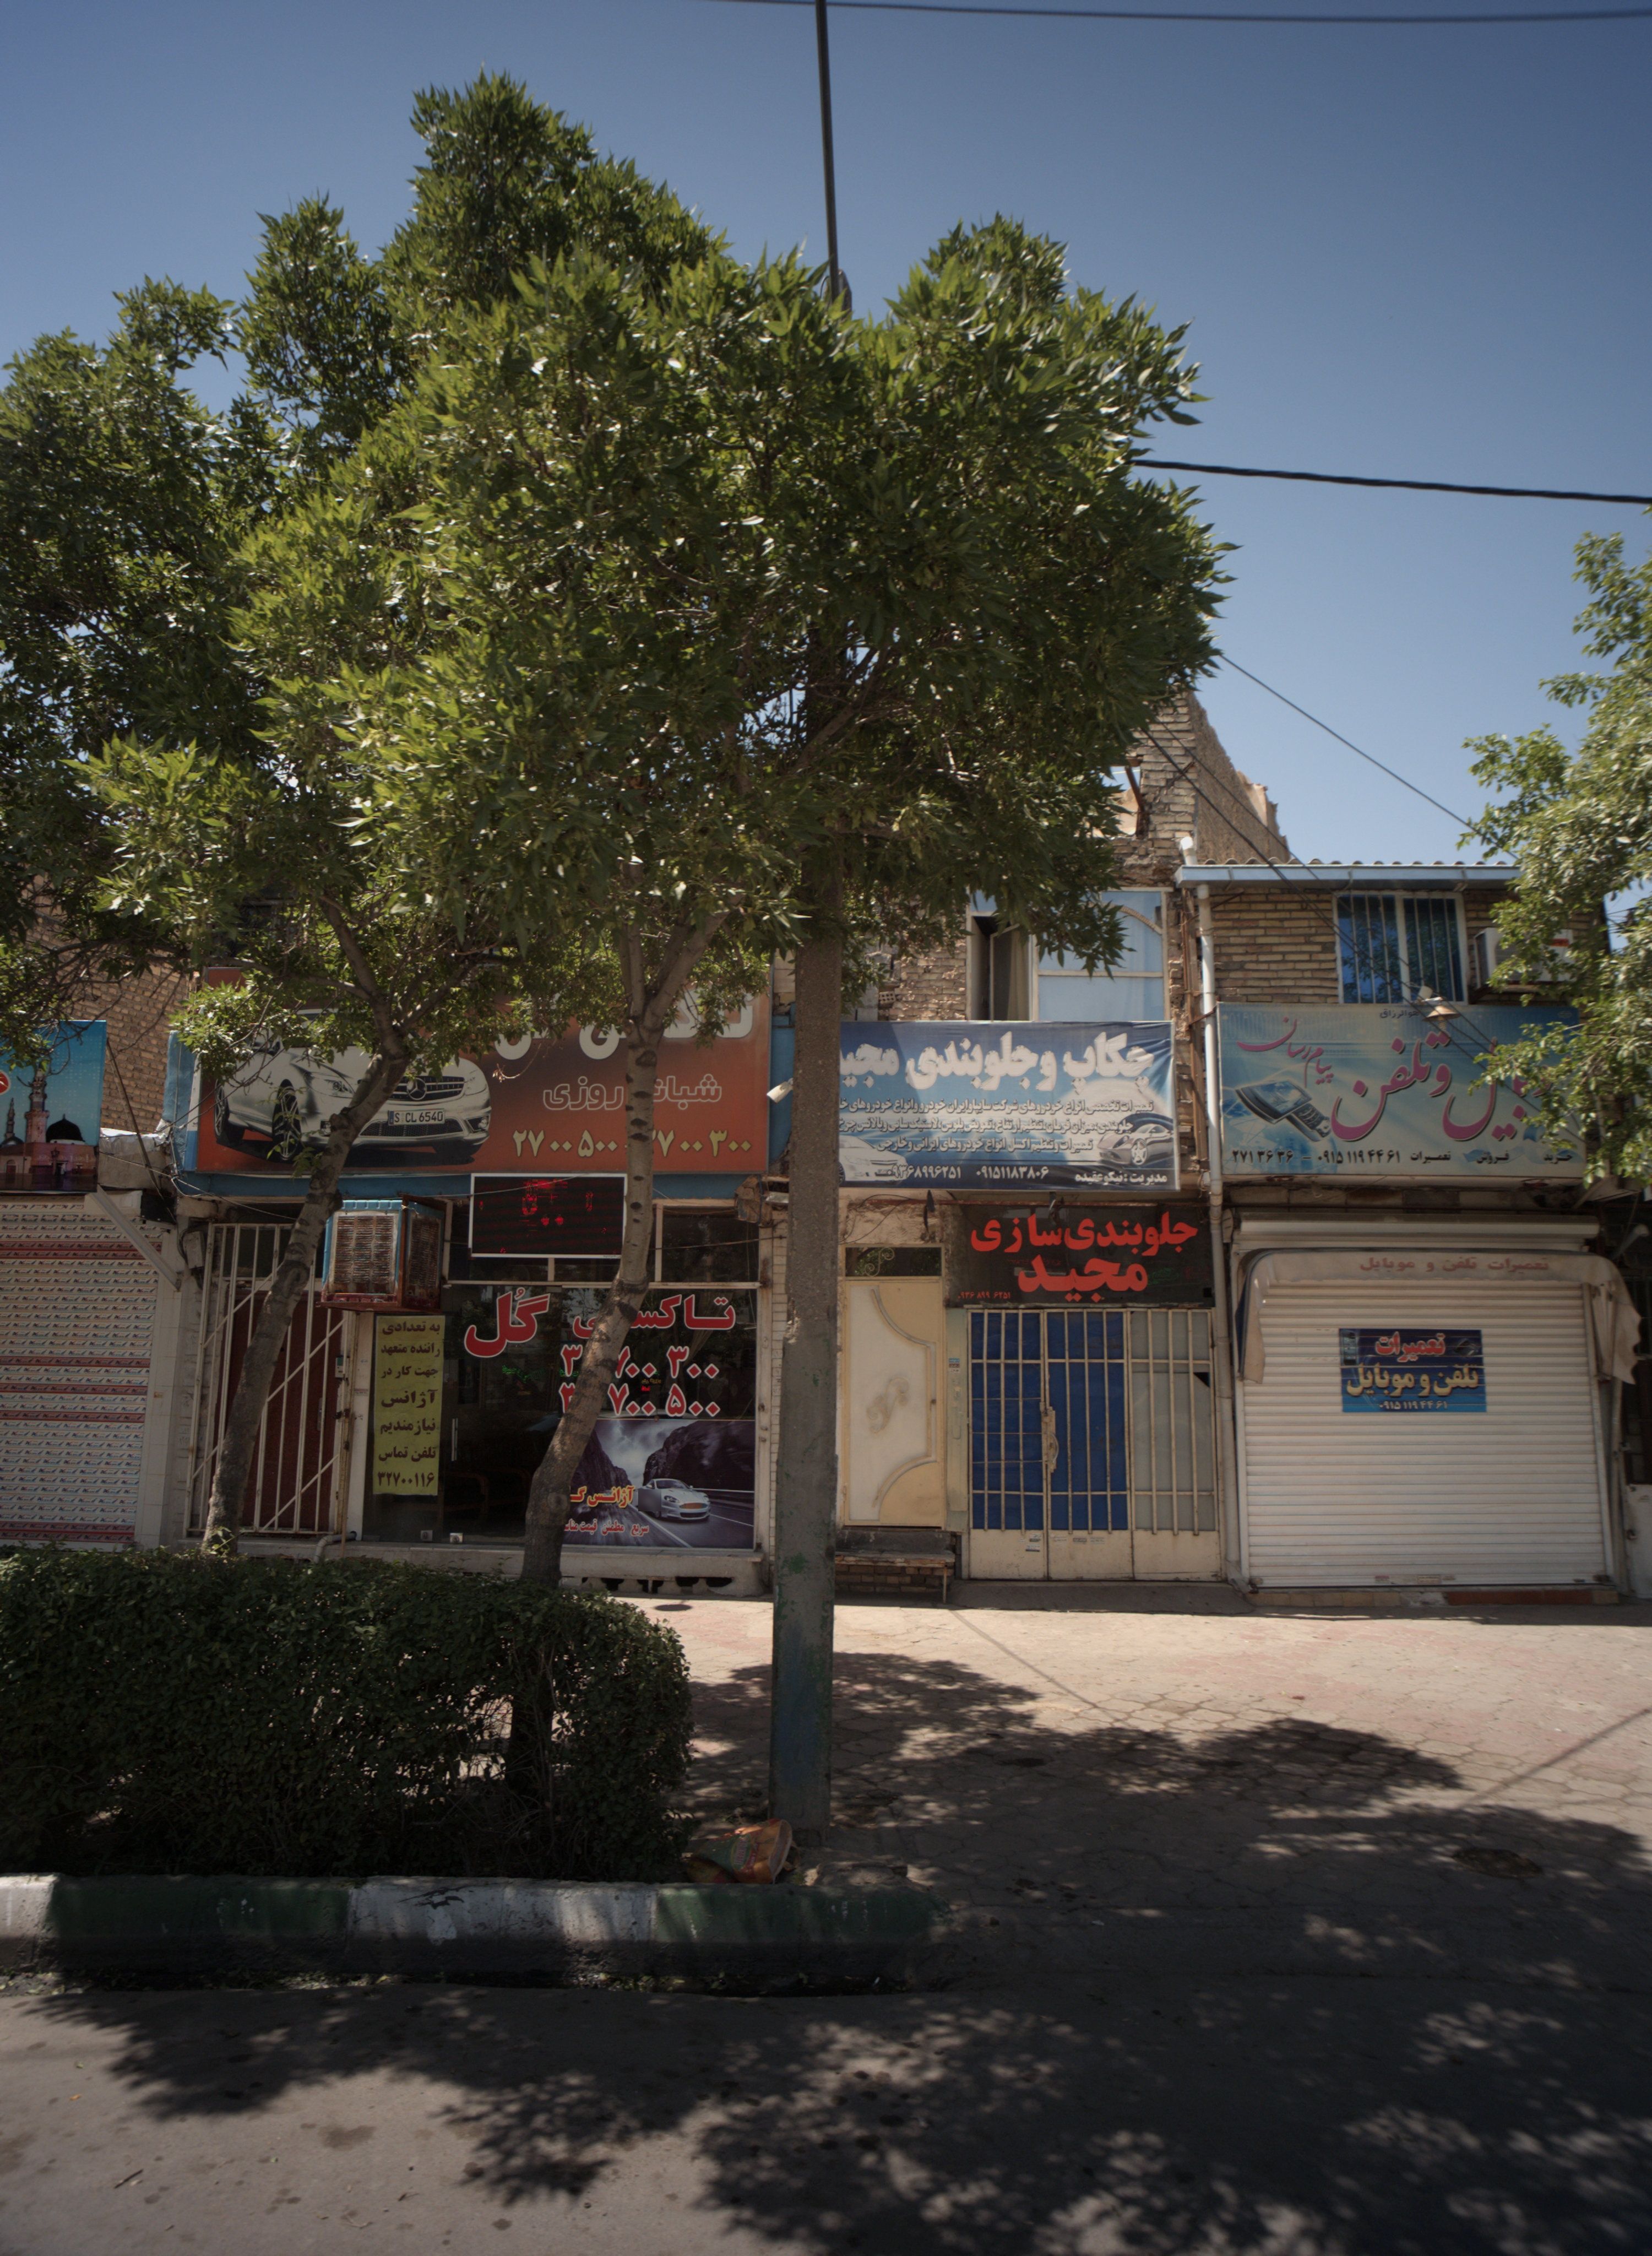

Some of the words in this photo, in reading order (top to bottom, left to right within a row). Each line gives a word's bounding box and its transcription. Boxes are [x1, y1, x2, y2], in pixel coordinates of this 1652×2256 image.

[840, 1043, 900, 1088] مجی
[1063, 1032, 1154, 1095] چکاپ
[543, 1076, 623, 1110] روزی
[654, 1073, 722, 1110] شبان
[1330, 1030, 1452, 1142] تلفن
[992, 1099, 1018, 1114] شرکت
[1063, 1099, 1085, 1115] انواع
[1085, 1099, 1120, 1115] تخصصی
[1120, 1100, 1154, 1114] تعمیرات
[394, 1112, 400, 1123] S
[405, 1112, 417, 1123] CL
[419, 1111, 444, 1122] 6540
[652, 1130, 751, 1157] ۷۰۰۳۰۰
[913, 1136, 939, 1152] ایرانی
[985, 1137, 1006, 1153] انواع
[1007, 1137, 1030, 1152] اکسل
[1061, 1137, 1094, 1153] تعمیرات
[1410, 1151, 1452, 1164] تعمیرات
[1476, 1149, 1510, 1164] فروش
[976, 1165, 1050, 1180] ۰۹۱۵۱۱۸۳۸۰۶
[970, 1213, 1062, 1253] سازی
[1064, 1211, 1198, 1256] جلوبندی
[1360, 1257, 1415, 1272] موبایل
[1426, 1262, 1434, 1272] و
[1443, 1256, 1477, 1272] تلفن
[1488, 1256, 1549, 1274] تعمیرات
[1018, 1254, 1149, 1303] مجید
[382, 1321, 426, 1335] تعدادی
[430, 1323, 440, 1335] به
[381, 1343, 407, 1354] متعهد
[410, 1342, 441, 1357] راننده
[1375, 1331, 1446, 1362] تعمیرات
[381, 1366, 392, 1378] در
[396, 1365, 412, 1378] کار
[415, 1366, 438, 1378] جهت
[1346, 1362, 1415, 1397] موبایل
[1418, 1374, 1431, 1397] و
[1433, 1363, 1480, 1397] تلفن
[381, 1389, 438, 1408] آژانس
[378, 1445, 408, 1462] تماس
[411, 1446, 437, 1462] تلفن
[378, 1471, 435, 1488] ۳۲۷۰۰۱۱۶
[587, 1485, 634, 1508] آژانس
[564, 1518, 579, 1531] مناس
[579, 1518, 598, 1536] قیمت
[631, 1523, 650, 1537] سریع
